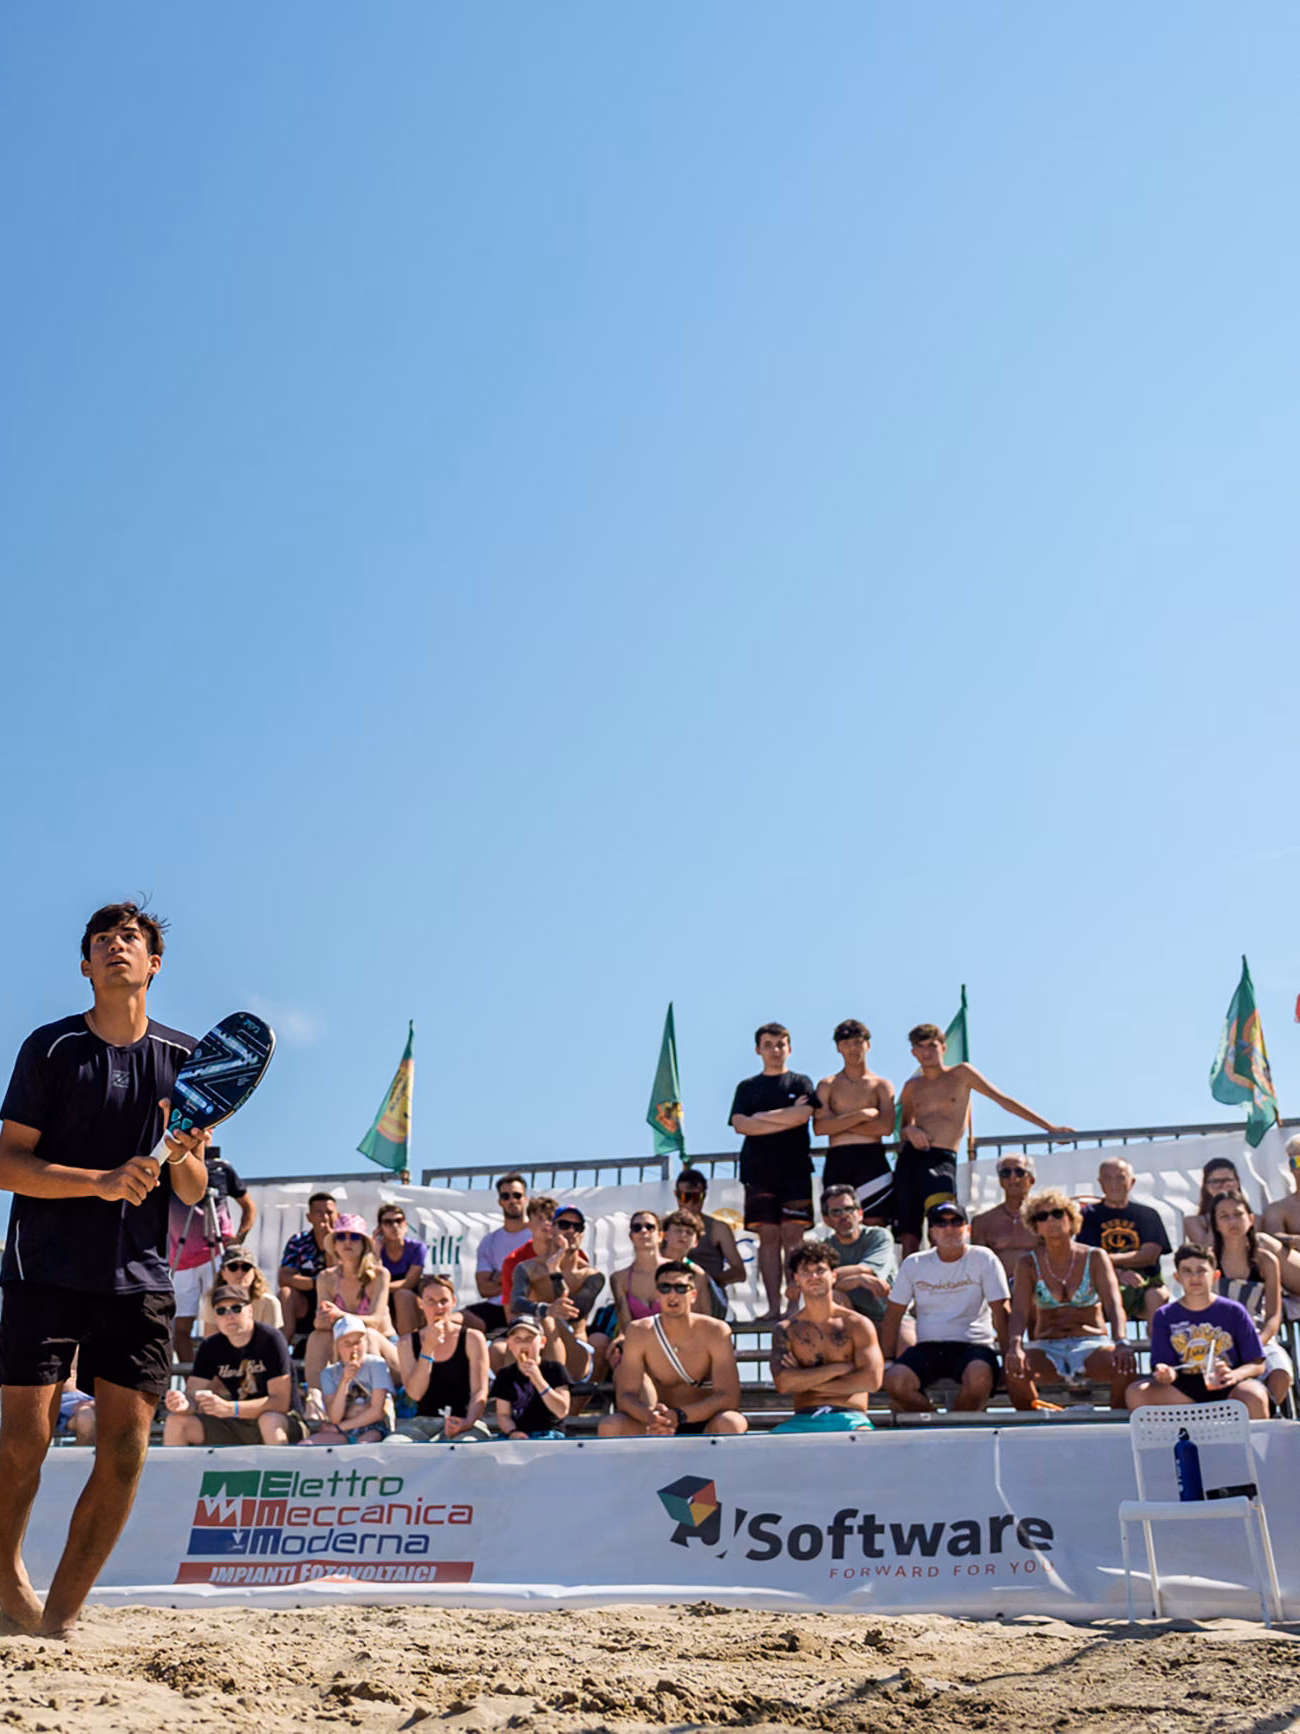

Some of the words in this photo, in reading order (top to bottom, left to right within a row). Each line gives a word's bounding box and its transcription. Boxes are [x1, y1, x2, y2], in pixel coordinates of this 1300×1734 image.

[260, 1469, 404, 1498] Elettro
[254, 1497, 474, 1527] Meccanica
[247, 1527, 430, 1556] Moderna
[208, 1565, 298, 1583] IMPIANTI
[299, 1564, 438, 1583] FOTOVOLTAICI
[829, 1564, 940, 1579] FORWARD
[953, 1563, 997, 1577] FOR
[1009, 1559, 1055, 1574] YOU
